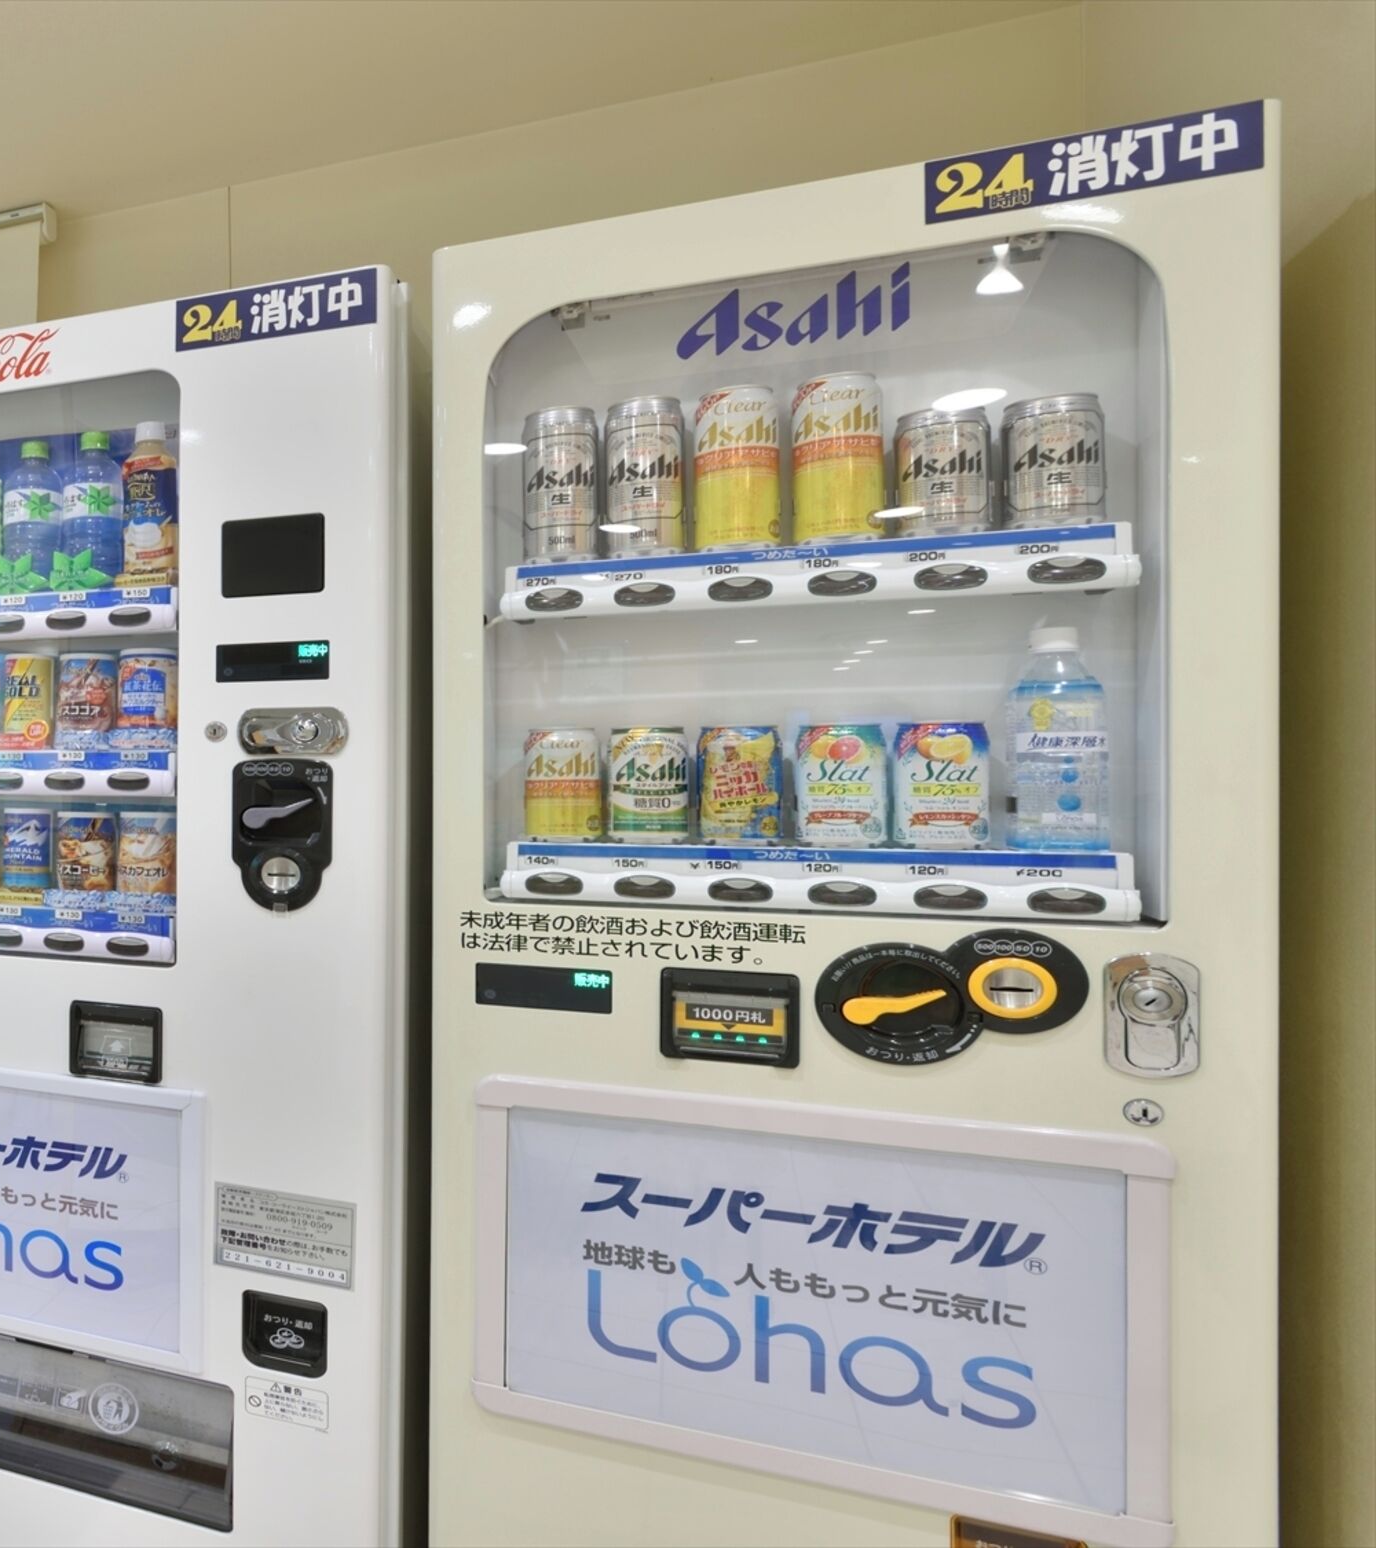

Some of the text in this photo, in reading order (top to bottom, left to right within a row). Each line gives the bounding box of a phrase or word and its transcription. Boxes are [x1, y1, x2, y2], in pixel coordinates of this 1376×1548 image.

[935, 152, 1034, 214] 24
[1047, 112, 1239, 196] 消灯中
[182, 299, 242, 343] 24
[250, 277, 363, 334] 消灯中
[675, 261, 911, 360] Asahi
[697, 416, 777, 452] Asahi
[794, 402, 878, 443] Asahi
[902, 449, 982, 483] Asahi
[1013, 438, 1099, 473] Asahi
[526, 462, 595, 494] Asahi
[608, 453, 679, 487] Asahi
[1046, 471, 1072, 485] 生
[551, 492, 571, 506] 生
[632, 485, 653, 498] 生
[930, 481, 955, 495] 生
[548, 535, 575, 546] 500ml
[1019, 544, 1060, 555] 200円
[805, 558, 839, 568] 180円
[909, 551, 946, 562] 200円
[707, 565, 739, 575] 180円
[526, 577, 556, 587] 270円
[527, 751, 595, 777] Asahi
[616, 756, 687, 782] Asahi
[807, 759, 870, 782] Slat
[911, 759, 978, 782] Slat
[526, 856, 555, 865] 140円
[614, 859, 644, 868] 150円
[806, 863, 838, 873] 120円
[908, 866, 945, 876] 120円
[459, 910, 806, 945] 未成年者の飲酒および飲酒運転
[460, 932, 764, 966] は法律で禁止されています。
[574, 972, 610, 990] 販売中
[692, 1007, 766, 1023] 1000円札
[580, 1172, 1046, 1269] スーパーホテル
[582, 1239, 1027, 1329] 地球も 人ももっと元気に
[587, 1268, 1037, 1429] Lohas
